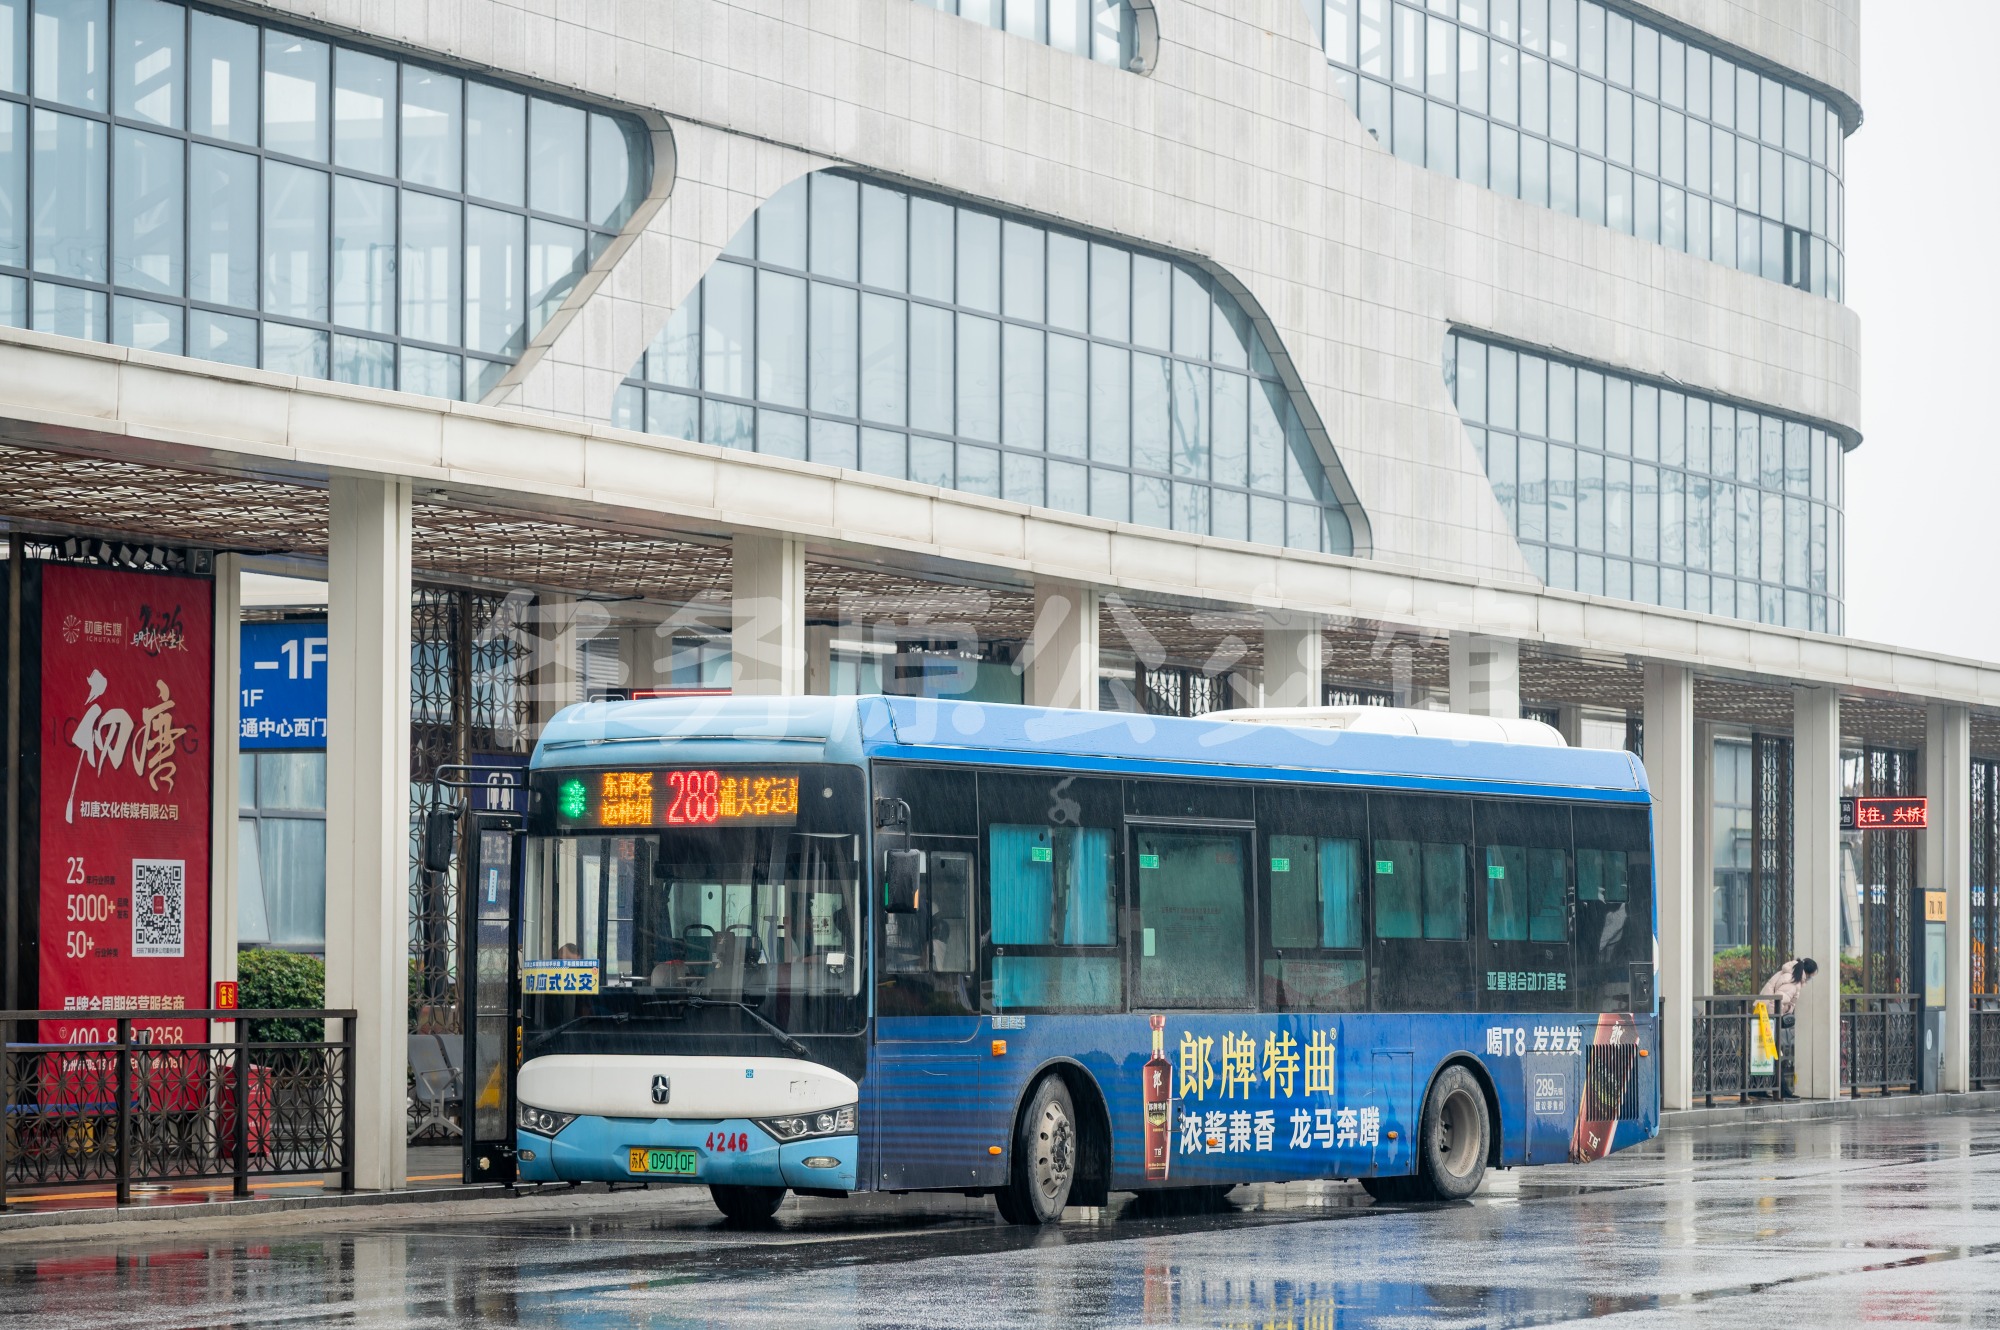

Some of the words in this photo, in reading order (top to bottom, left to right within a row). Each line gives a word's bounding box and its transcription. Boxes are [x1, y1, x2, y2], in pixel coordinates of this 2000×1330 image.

[84, 621, 122, 636] 初唐传媒
[86, 636, 120, 645] ICHUTANG
[242, 689, 264, 707] 1F
[239, 717, 327, 738] 通中心西门
[65, 668, 187, 824] 初唐
[602, 772, 653, 797] 东部客
[668, 770, 719, 823] 288
[80, 801, 178, 820] 初唐文化传媒有限公司
[602, 799, 653, 825] 运枢纽
[67, 856, 85, 884] 23
[67, 894, 116, 922] 5000+
[67, 930, 95, 958] 50+
[525, 973, 593, 992] 响应式公交
[1487, 971, 1566, 992] 亚星混合动力客车
[64, 995, 185, 1011] 品牌全周期经营服务商
[1487, 1026, 1526, 1057] 喝T8
[1533, 1026, 1582, 1056] 发发发
[1179, 1029, 1336, 1102] 郎牌特曲
[1536, 1100, 1564, 1111] 建议零售价
[1179, 1109, 1275, 1154] 浓酱兼香
[1290, 1105, 1380, 1149] 龙马奔腾
[705, 1131, 748, 1152] 4246
[631, 1152, 647, 1170] 苏K
[651, 1153, 694, 1171] 09010F
